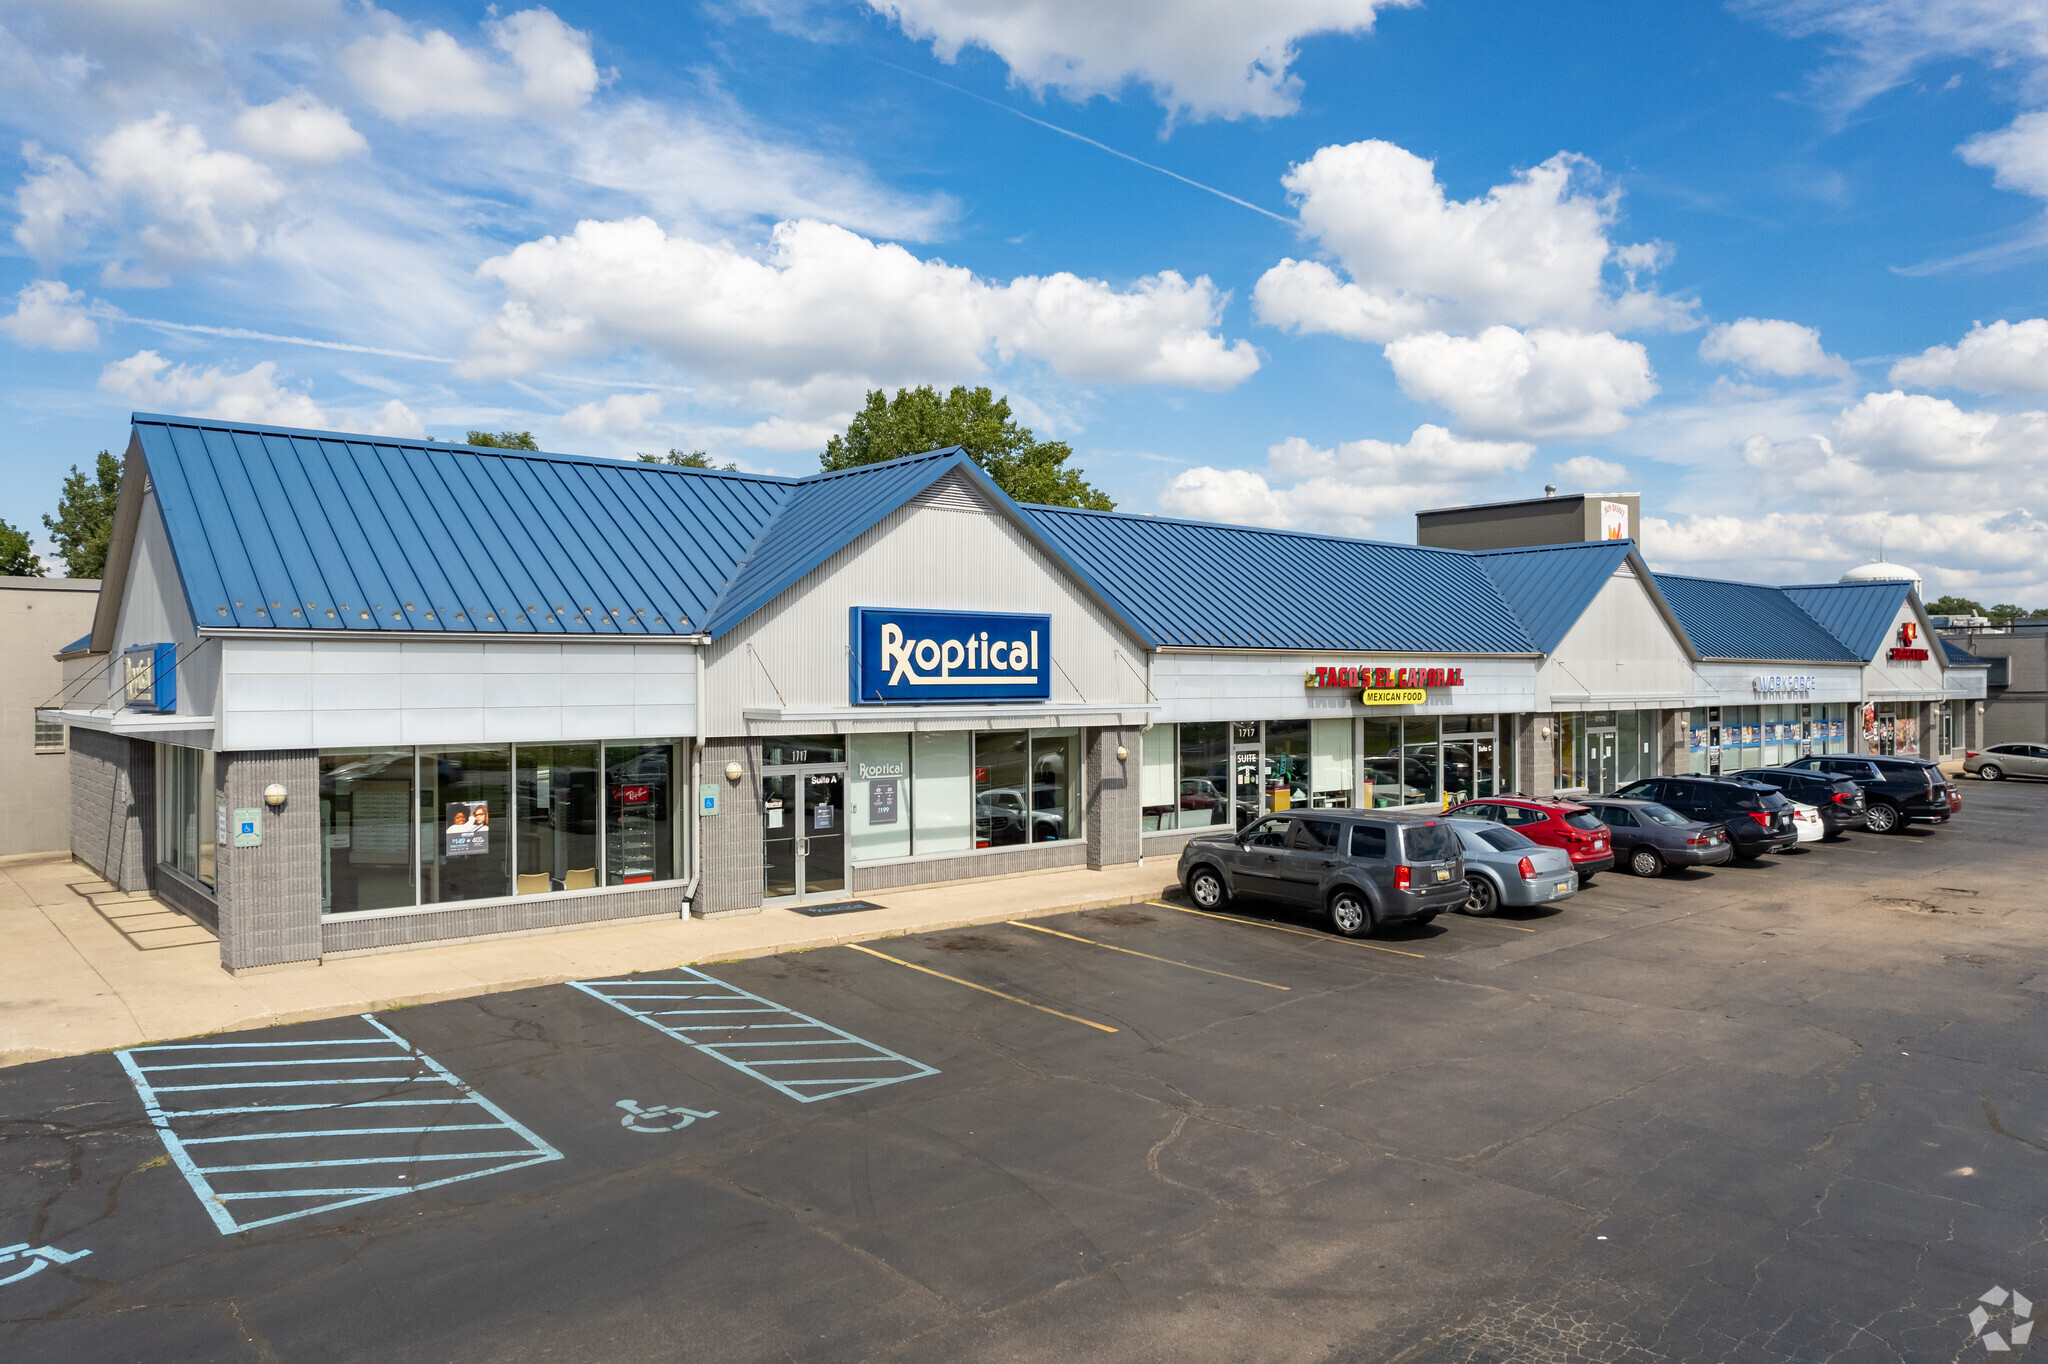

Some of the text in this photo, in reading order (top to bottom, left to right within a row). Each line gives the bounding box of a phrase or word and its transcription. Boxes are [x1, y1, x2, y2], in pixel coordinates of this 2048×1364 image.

[1315, 665, 1464, 687] TACO'S EL CAPORAL
[1759, 676, 1816, 691] WORKFORCE
[1367, 691, 1422, 702] MEXICAN FOOD
[1238, 728, 1255, 738] 1717
[792, 750, 808, 762] 1717
[1237, 753, 1257, 763] SUITE
[811, 774, 838, 785] Suite A
